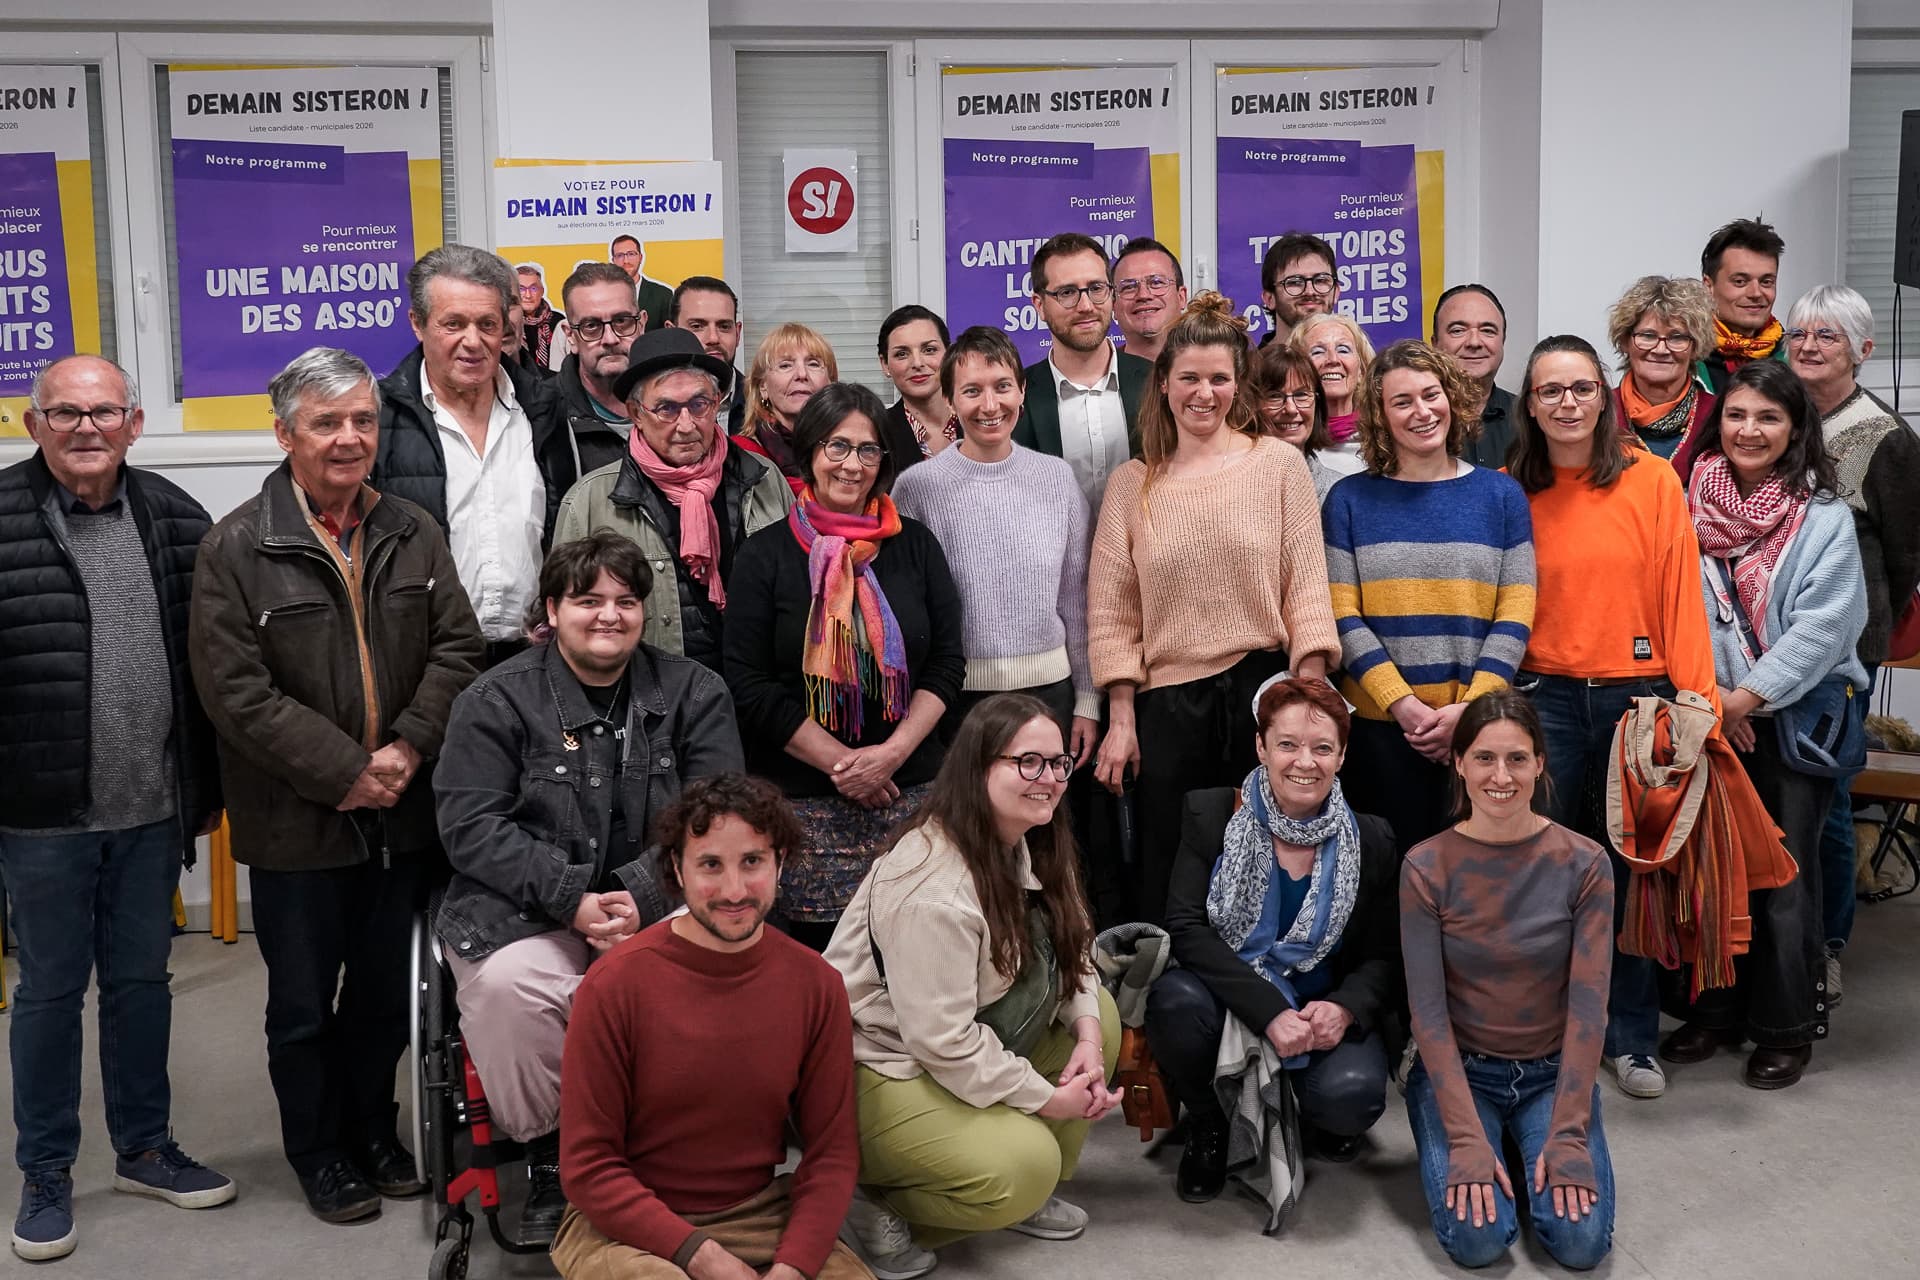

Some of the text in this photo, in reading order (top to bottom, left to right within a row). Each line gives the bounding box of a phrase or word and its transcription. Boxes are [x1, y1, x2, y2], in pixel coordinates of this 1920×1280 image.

[67, 87, 76, 108] !
[187, 88, 429, 115] DEMAIN SISTERON !
[957, 87, 1169, 116] DEMAIN SISTERON !
[1231, 86, 1435, 115] DEMAIN SISTERON !
[249, 125, 267, 133] Liste
[268, 124, 304, 132] candidate
[310, 123, 354, 132] municipales
[355, 122, 374, 130] 2026
[1011, 124, 1026, 132] Liste
[1028, 122, 1060, 131] candidate
[1065, 121, 1103, 129] municipales
[1298, 121, 1328, 129] candidate
[1333, 119, 1370, 127] municipales
[206, 154, 327, 171] Notre programme
[972, 152, 1079, 166] Notre programme
[1245, 150, 1346, 164] Notre programme
[563, 179, 645, 191] VOTEZ POUR
[507, 193, 712, 218] DEMAIN SISTERON !
[1070, 195, 1136, 208] Pour mieux
[1340, 192, 1404, 206] Pour mieux
[0, 206, 40, 218] mieux
[1089, 209, 1136, 222] manger
[1334, 206, 1404, 220] se déplacer
[322, 223, 397, 237] Pour mieux
[302, 239, 398, 253] se rencontrer
[0, 249, 47, 278] US
[206, 262, 399, 297] UNE MAISON
[1337, 262, 1406, 292] STES
[242, 303, 302, 334] DES
[0, 321, 54, 351] ITS
[22, 360, 31, 369] la
[4, 372, 28, 381] zone
